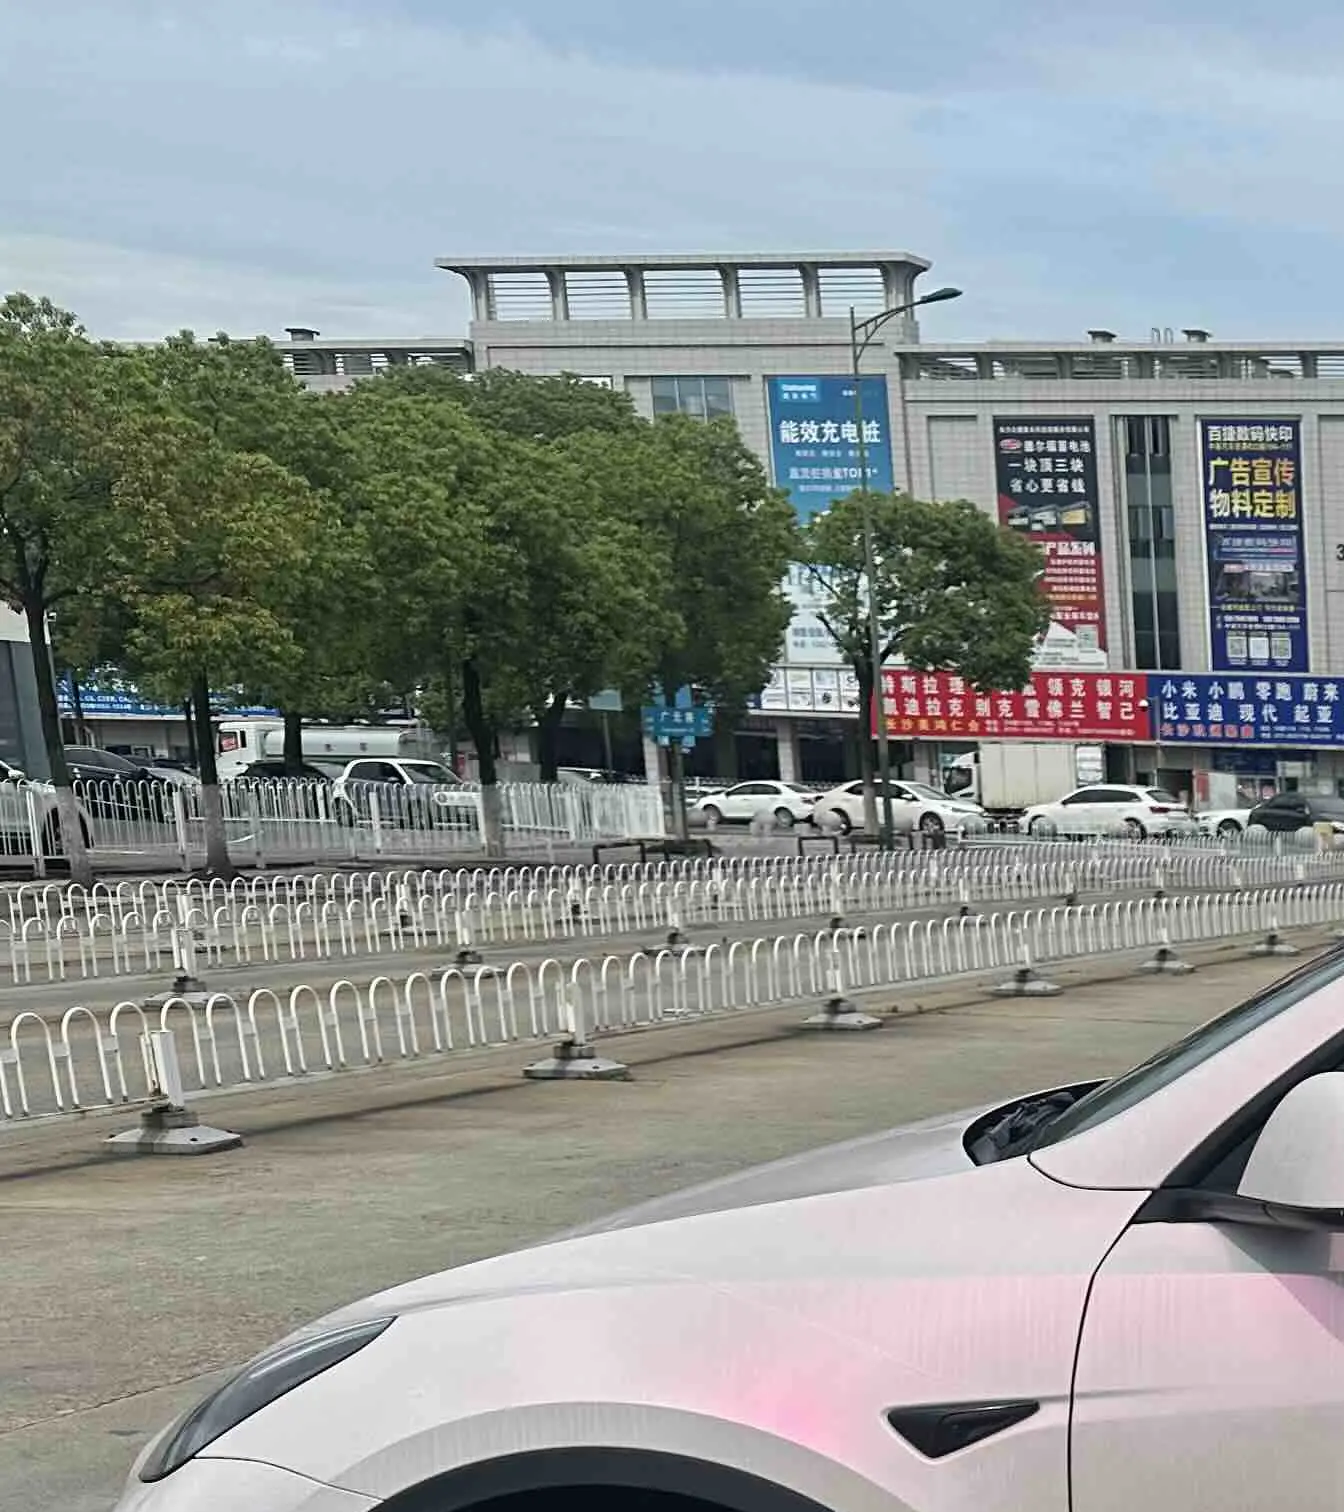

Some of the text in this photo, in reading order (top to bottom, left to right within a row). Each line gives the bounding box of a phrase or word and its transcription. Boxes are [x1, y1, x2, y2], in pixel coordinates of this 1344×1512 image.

[1208, 457, 1296, 486] 广告宣传
[1209, 488, 1298, 519] 物料定制
[881, 676, 939, 695] 特斯拉
[1161, 680, 1198, 699] 小米
[1208, 681, 1246, 700] 小鹏
[976, 699, 1014, 718] 别克
[1097, 700, 1135, 720] 智己
[1163, 703, 1225, 722] 比亚迪
[1239, 703, 1278, 722] 现代
[1294, 705, 1333, 724] 起亚
